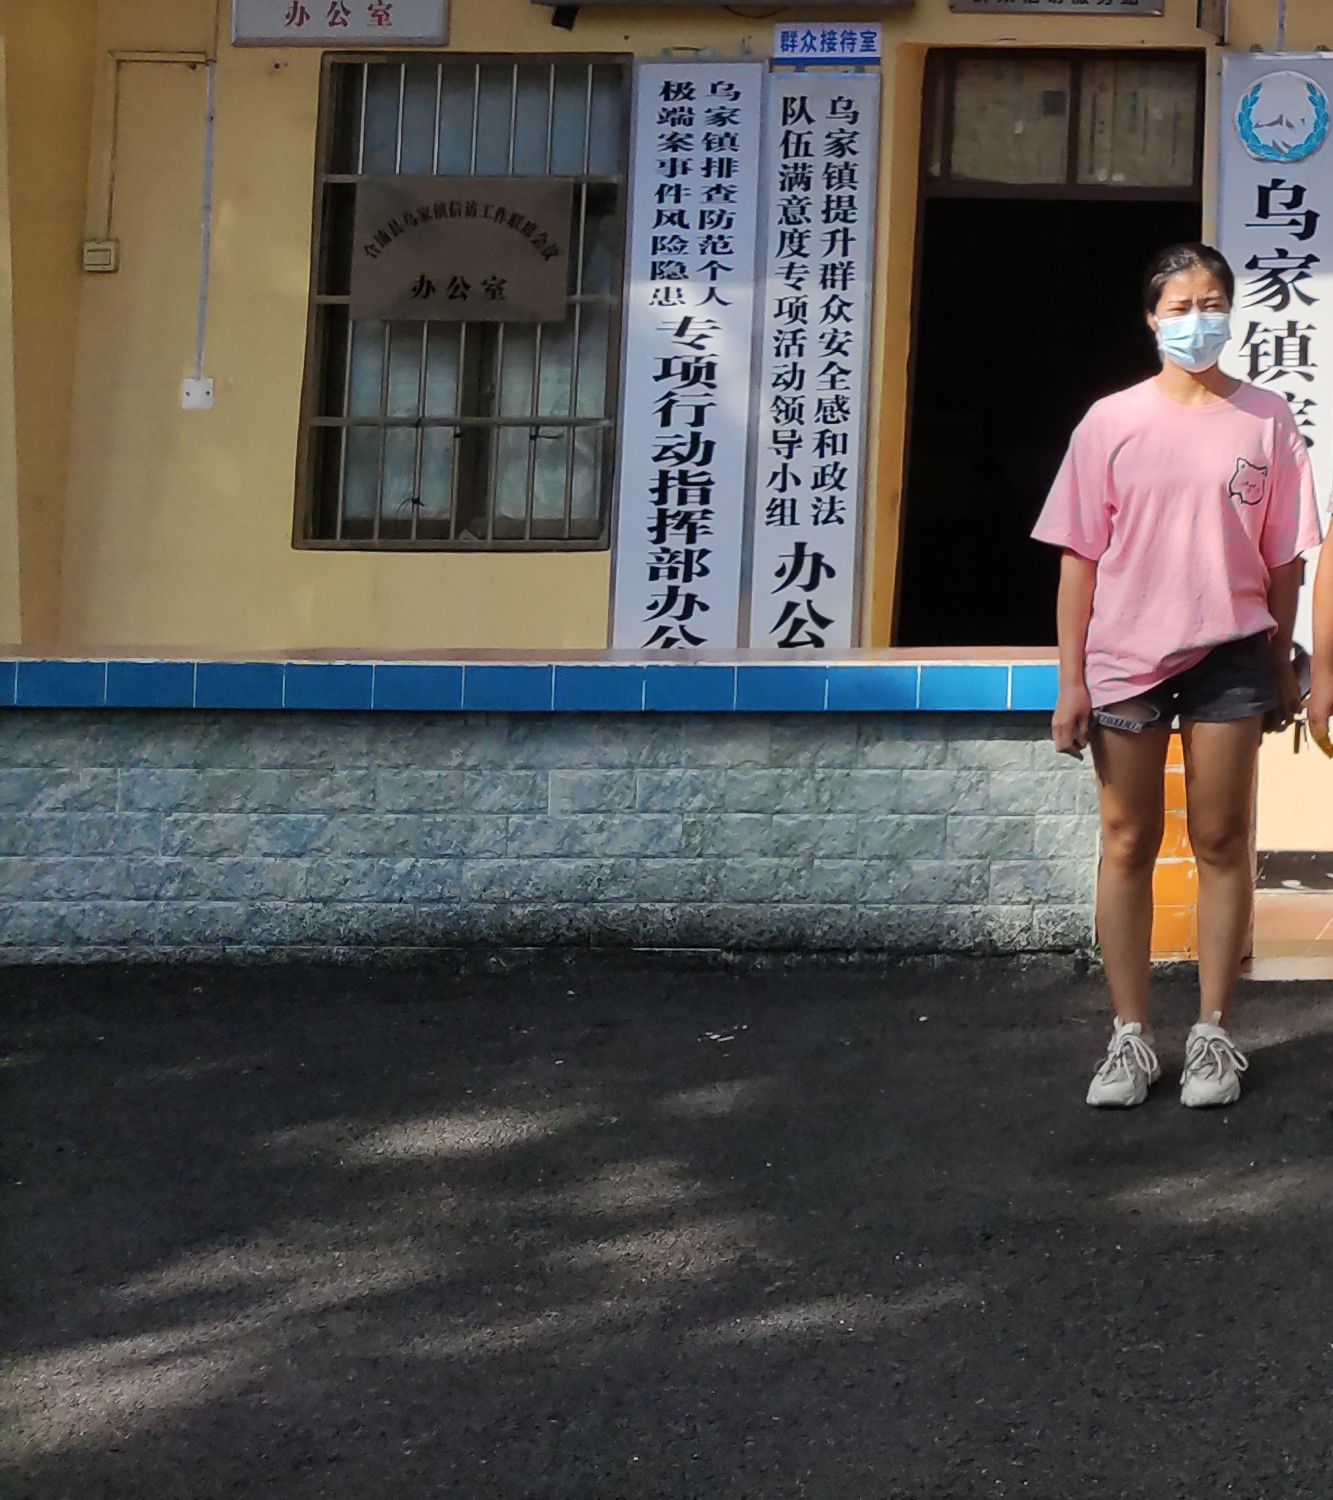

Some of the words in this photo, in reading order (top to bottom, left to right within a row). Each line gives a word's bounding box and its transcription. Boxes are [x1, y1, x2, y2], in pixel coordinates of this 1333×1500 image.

[284, 0, 395, 29] 办公室
[779, 28, 879, 55] 群众接待室
[648, 79, 697, 308] 极端案事件风险隐患
[694, 79, 743, 308] 乌家镇排查防范个人
[411, 274, 508, 301] 办公室
[764, 95, 818, 528] 队伍满意度专项活动领导小组
[809, 95, 862, 527] 乌家镇提升群众安全感和政法
[768, 540, 837, 649] 办公
